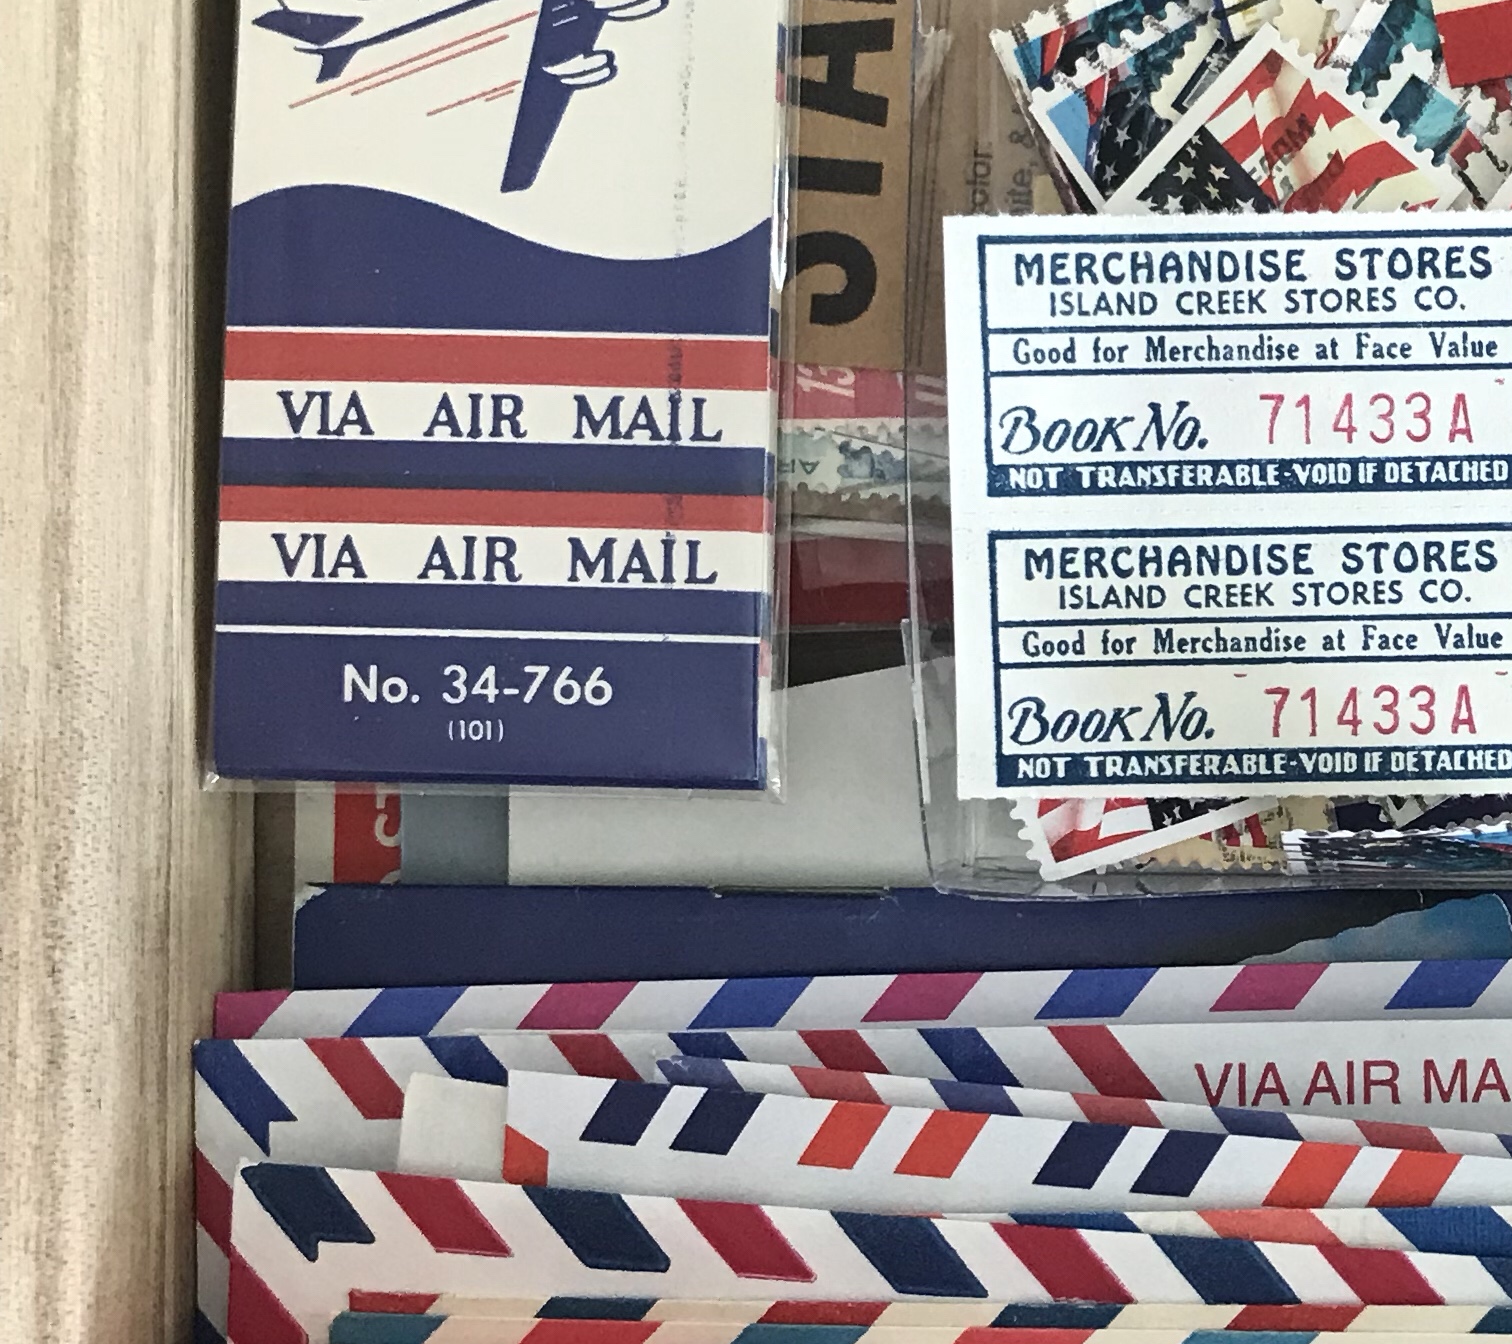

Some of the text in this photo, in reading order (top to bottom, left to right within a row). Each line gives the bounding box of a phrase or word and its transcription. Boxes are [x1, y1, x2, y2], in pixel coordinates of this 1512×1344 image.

[1015, 245, 1493, 286] MERCHANDISE STORES
[1049, 285, 1467, 317] ISLAND CREEK STORES CO.
[1013, 329, 1499, 364] Good for Merchandise at Face Value
[276, 389, 724, 443] VIA AIR MAIL
[1132, 400, 1209, 452] No.
[1259, 392, 1474, 447] 71433A
[1009, 464, 1060, 490] NOT
[1357, 464, 1378, 484] IF
[1385, 458, 1509, 485] DETACHED
[271, 532, 718, 585] VIA AIR MAIL
[1024, 540, 1498, 579] MERCHANDISE STORES
[1058, 579, 1472, 610] ISLAND CREEK STORES CO.
[1022, 623, 1504, 656] Good for Merchandise at Face Value
[342, 664, 615, 706] No. 34-766
[447, 719, 505, 743] (101)
[1139, 689, 1215, 741] No.
[1263, 685, 1478, 738] 71433A
[1017, 757, 1067, 780] NOT
[1364, 755, 1384, 775] IF
[1391, 749, 1512, 776] DETACHED
[1195, 1062, 1290, 1108] VIA
[1305, 1059, 1401, 1106] AIR
